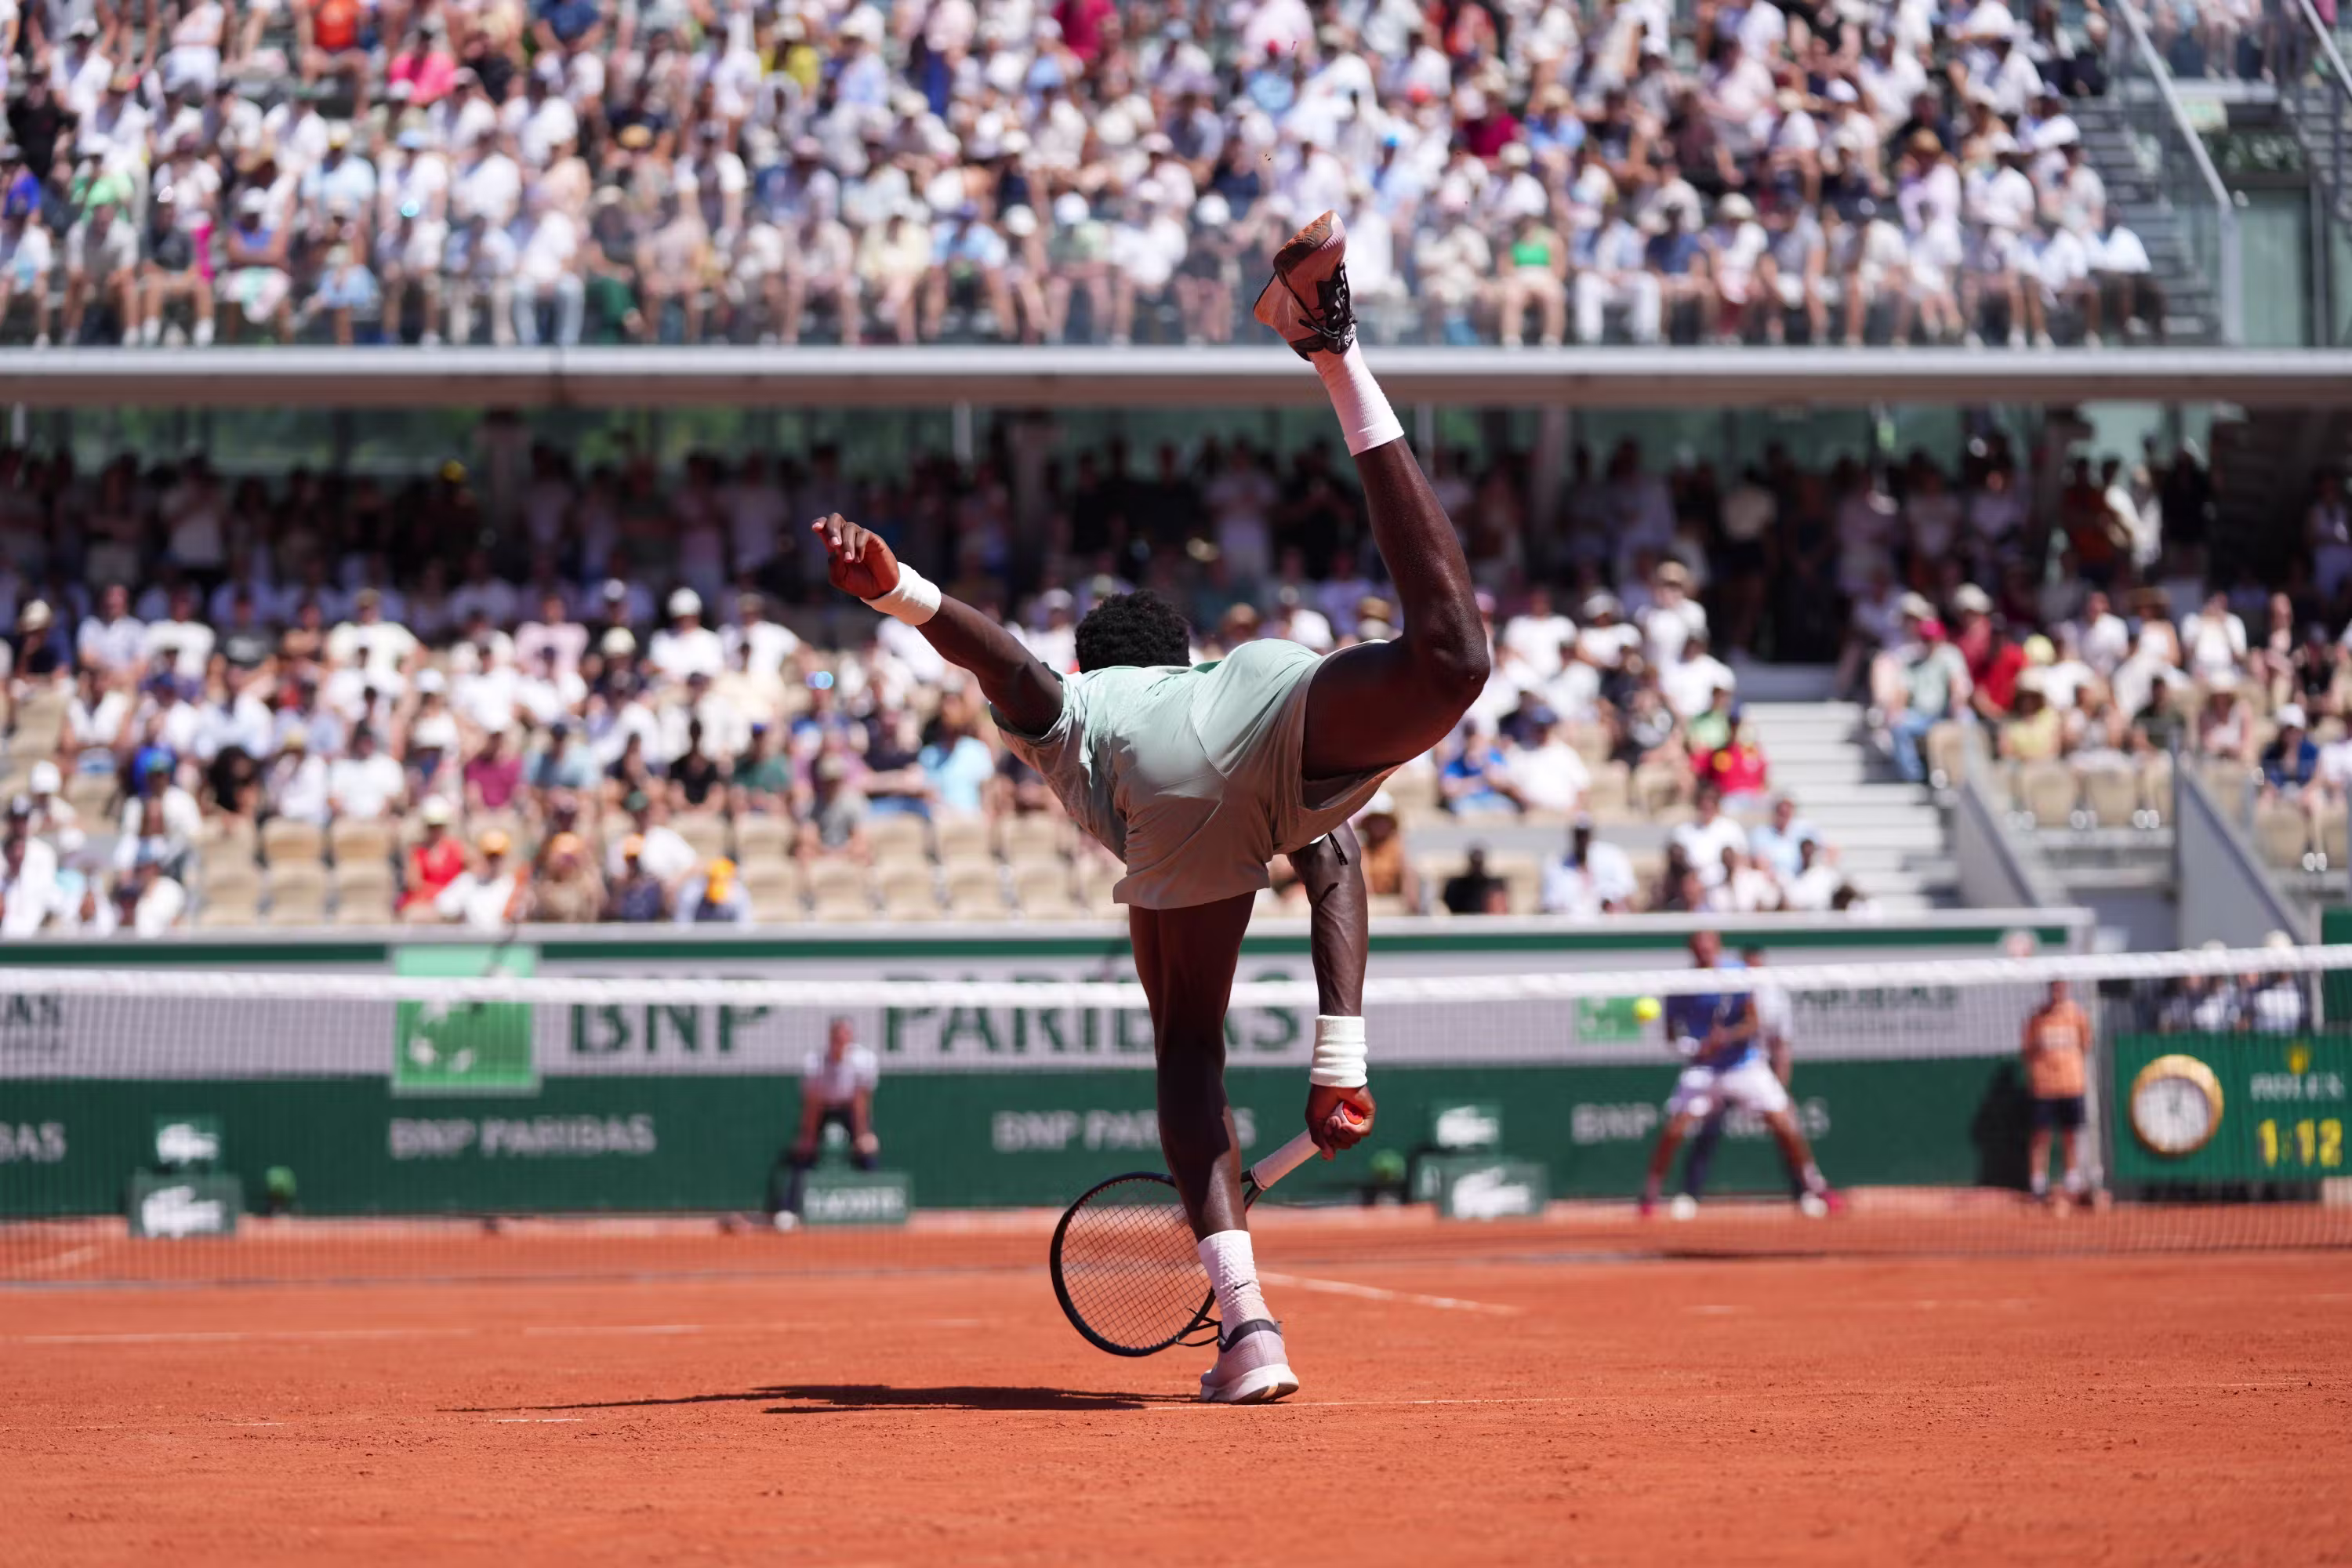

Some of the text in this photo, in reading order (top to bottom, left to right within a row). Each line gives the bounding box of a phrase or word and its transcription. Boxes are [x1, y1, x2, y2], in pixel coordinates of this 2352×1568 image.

[570, 974, 771, 1054] BNP
[389, 1113, 656, 1160] BNP PARIBAS
[992, 1111, 1079, 1152] BNP
